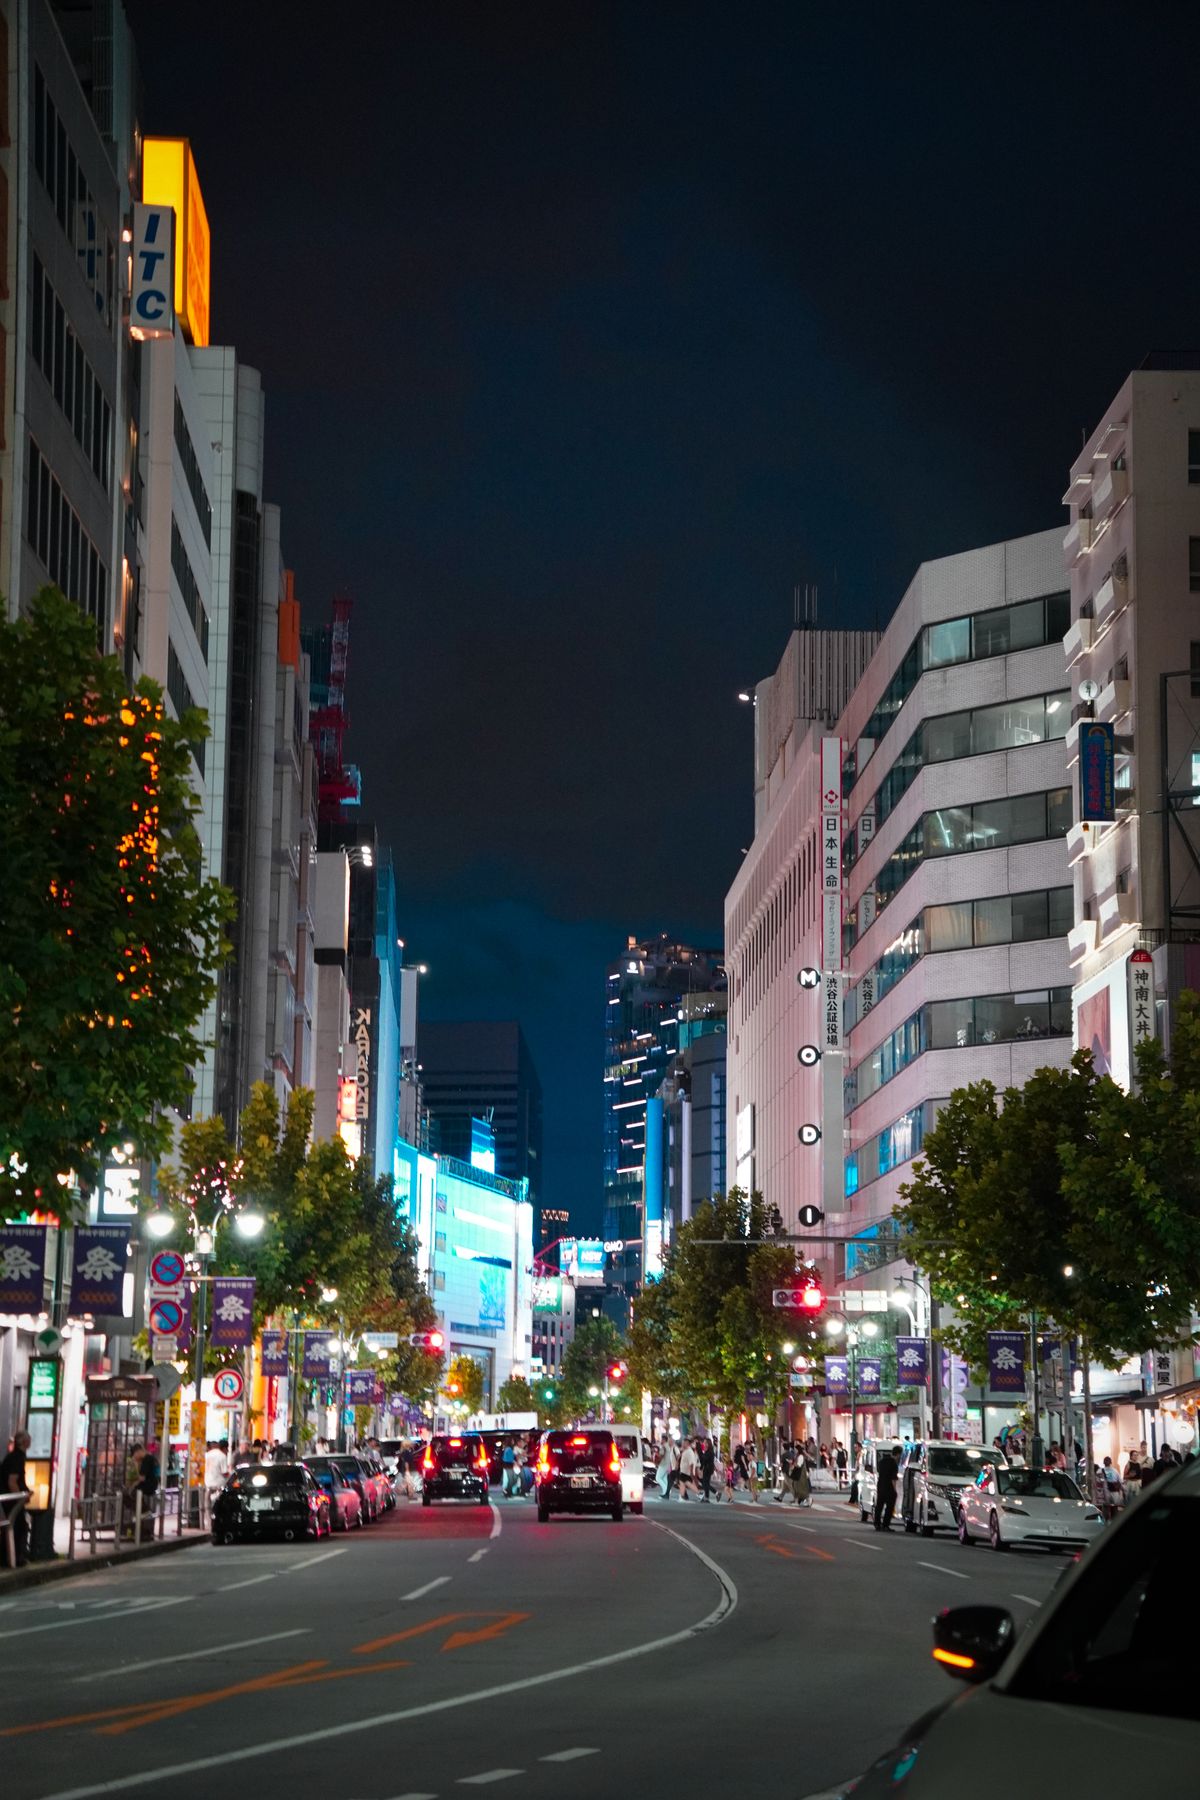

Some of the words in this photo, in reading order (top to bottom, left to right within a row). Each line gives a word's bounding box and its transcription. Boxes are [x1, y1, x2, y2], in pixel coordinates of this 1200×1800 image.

[136, 213, 167, 320] ITC
[825, 818, 838, 888] 日本生命
[826, 977, 839, 1046] 渋谷公証役場
[1134, 969, 1151, 1046] 神南大井
[603, 1240, 624, 1253] GMO
[76, 1245, 123, 1282] 祭
[216, 1294, 251, 1323] 祭
[899, 1347, 924, 1368] 祭
[992, 1346, 1022, 1370] 祭
[827, 1366, 846, 1382] 祭
[861, 1366, 880, 1382] 祭
